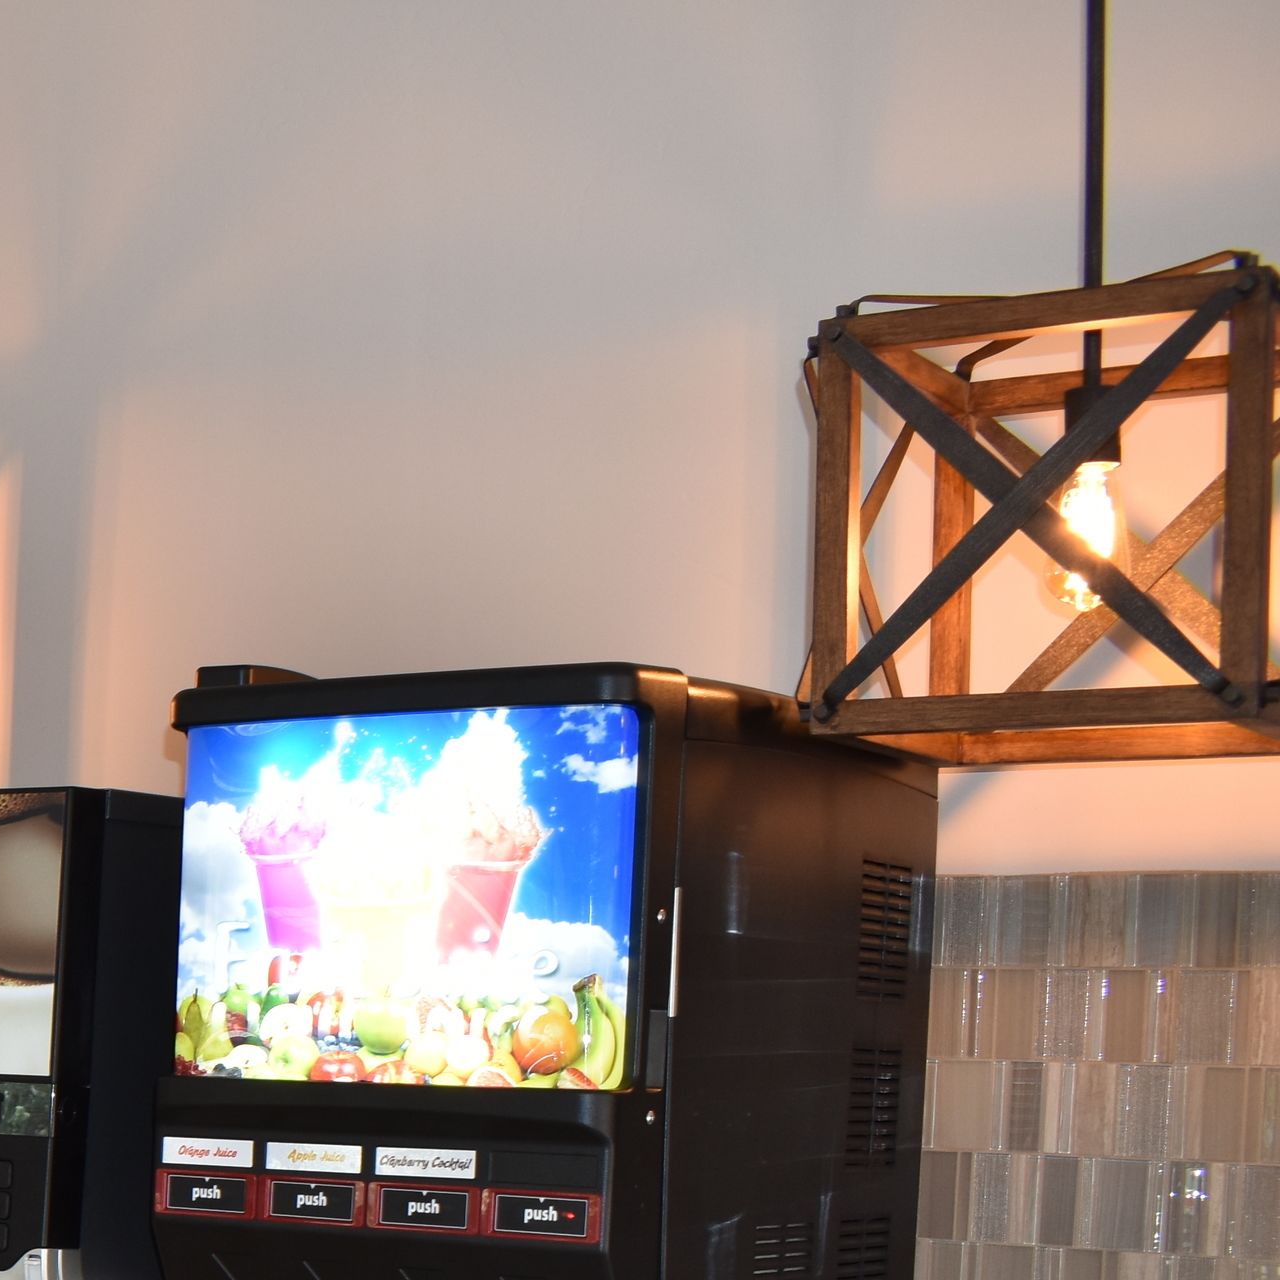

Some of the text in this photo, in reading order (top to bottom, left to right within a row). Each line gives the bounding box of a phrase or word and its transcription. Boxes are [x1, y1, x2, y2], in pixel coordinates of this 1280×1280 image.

[178, 1144, 238, 1161] Orange Juice
[287, 1148, 346, 1165] Apple Juice
[379, 1154, 473, 1171] Cranberry Cocktail
[191, 1185, 222, 1201] push
[296, 1192, 327, 1209] push
[407, 1199, 440, 1216] push
[523, 1206, 558, 1223] push
